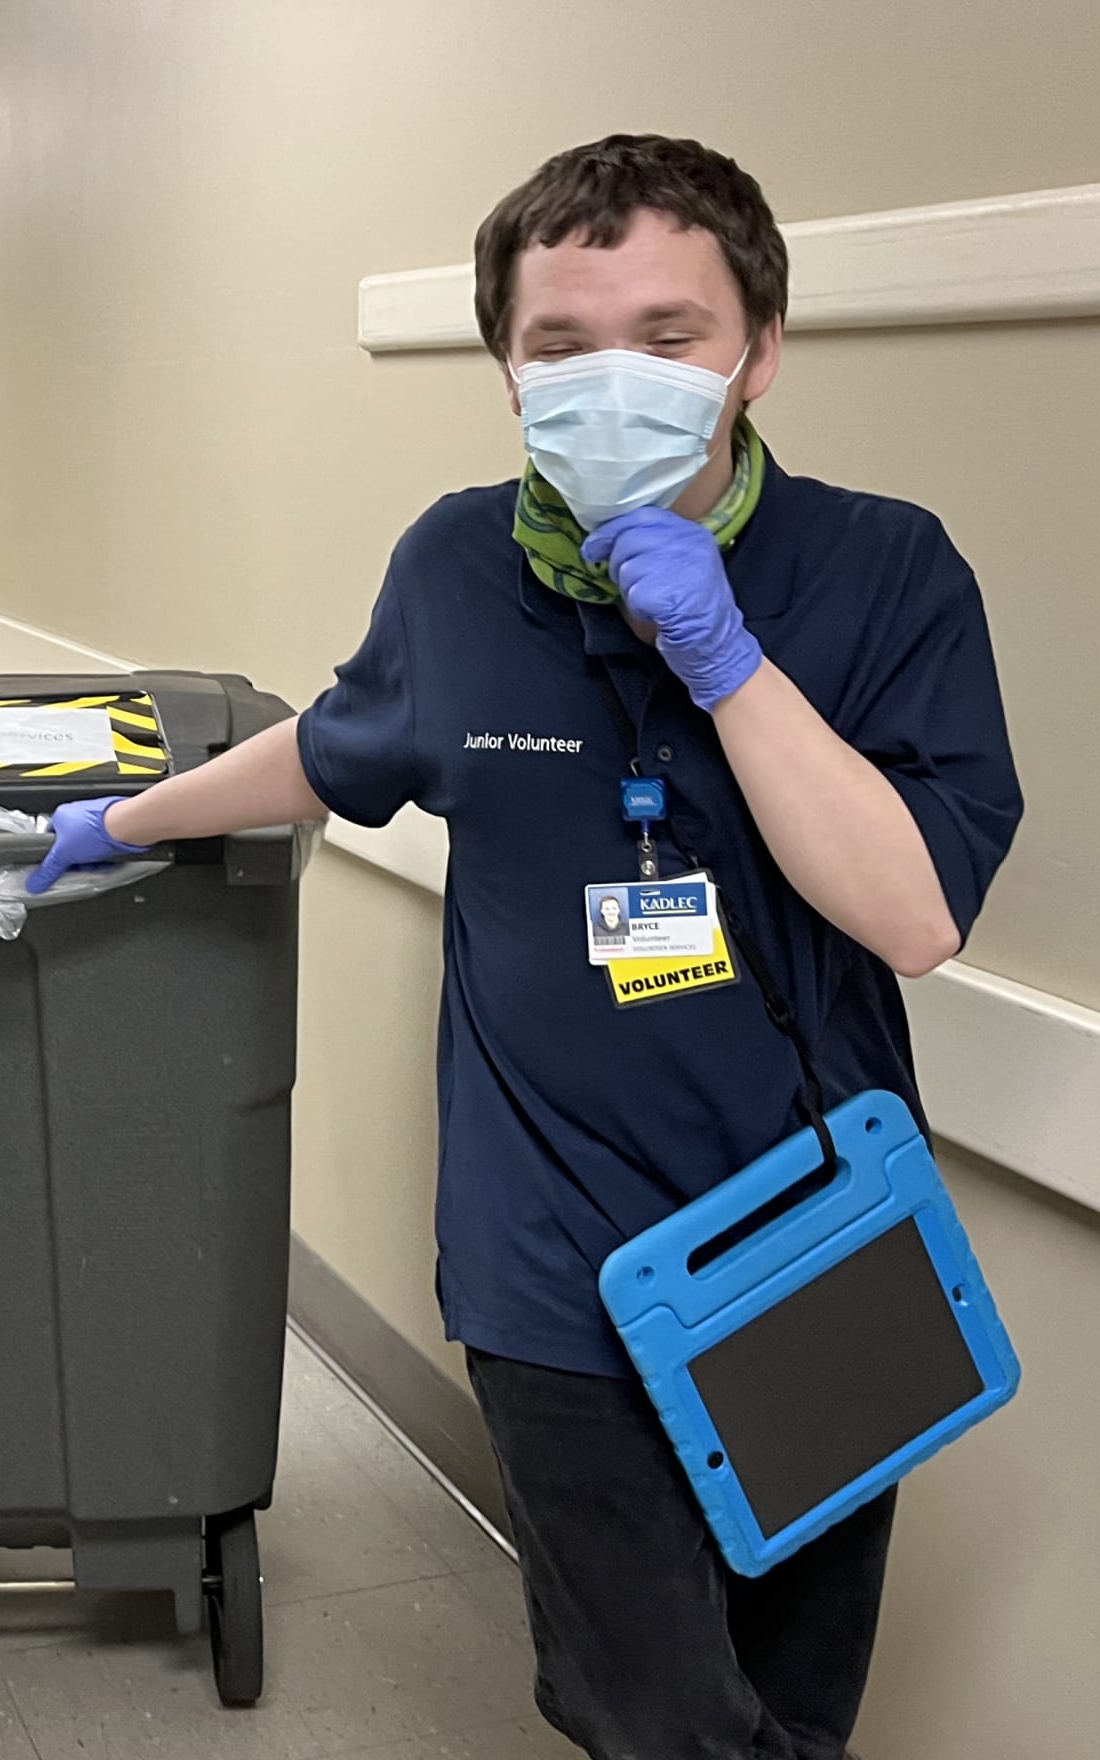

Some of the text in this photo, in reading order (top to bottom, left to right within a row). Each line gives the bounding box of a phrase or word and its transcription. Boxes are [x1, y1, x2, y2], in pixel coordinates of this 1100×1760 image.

[463, 732, 583, 753] Junior Volunteer
[640, 896, 698, 911] KADLEC
[631, 922, 660, 931] BRYCE
[632, 935, 671, 943] Volunteer
[619, 960, 729, 996] VOLUNTEER
